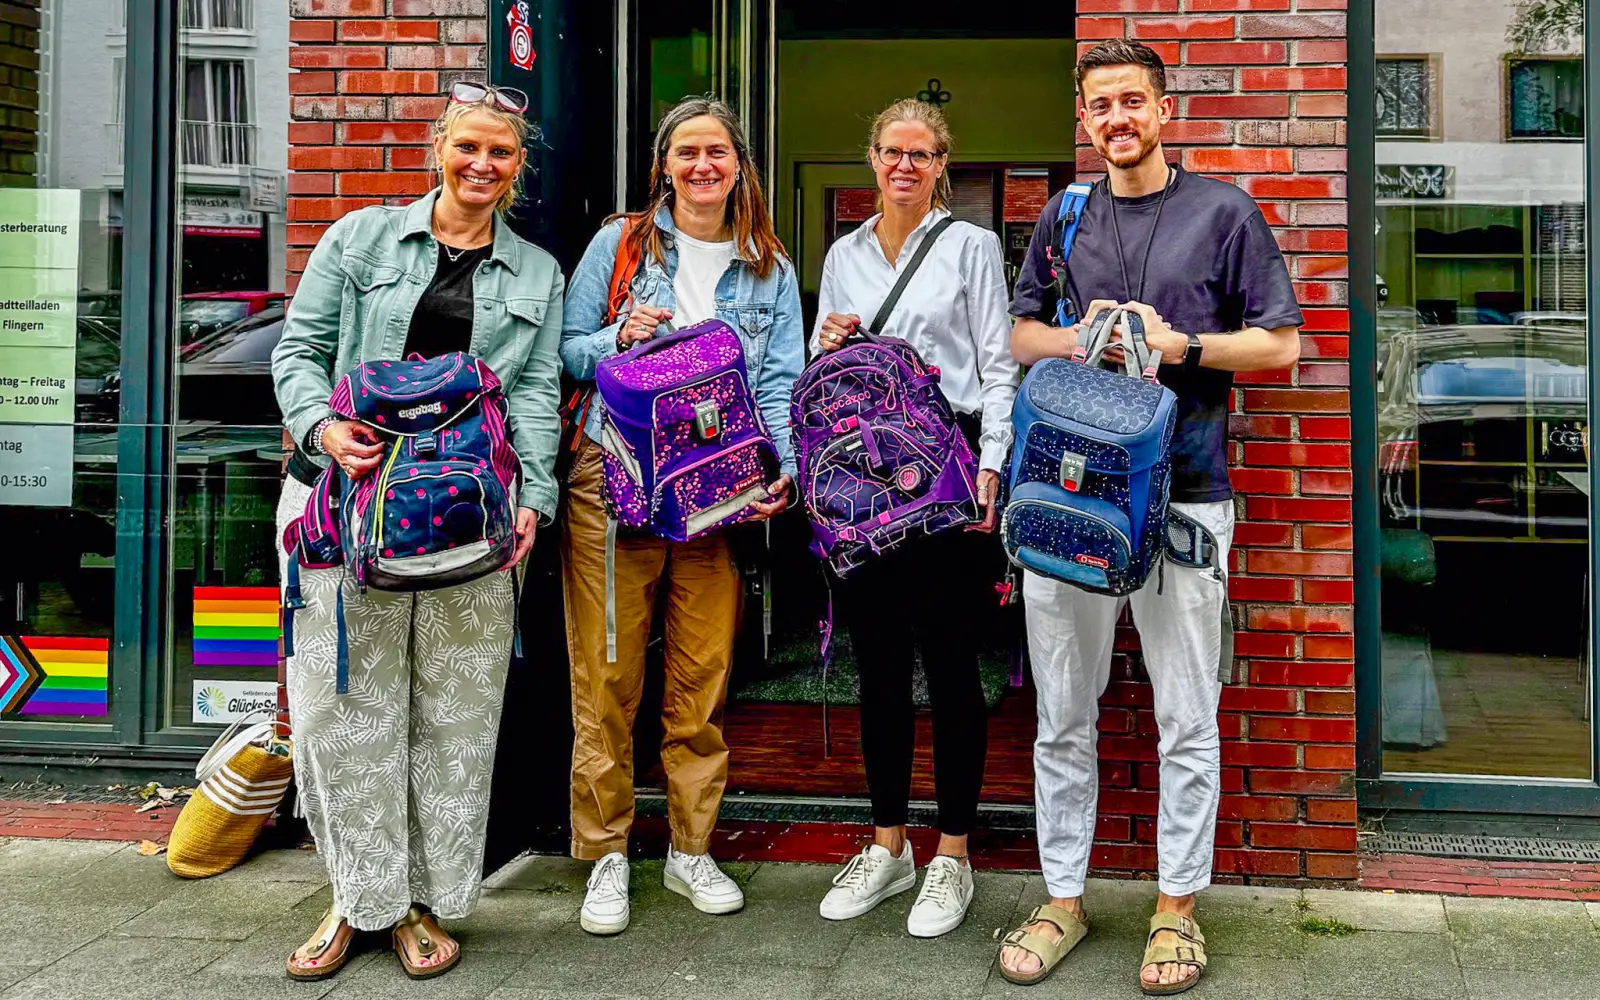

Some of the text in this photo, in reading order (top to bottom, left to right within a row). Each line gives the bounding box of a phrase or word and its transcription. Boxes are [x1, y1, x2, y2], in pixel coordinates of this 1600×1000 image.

[0, 222, 68, 235] sterberatung
[2, 319, 44, 332] Flingern
[30, 377, 66, 388] Freitag
[14, 396, 40, 405] 12.00
[41, 396, 59, 406] Uhr
[398, 401, 441, 420] ergobag
[0, 474, 47, 488] 0-15:30
